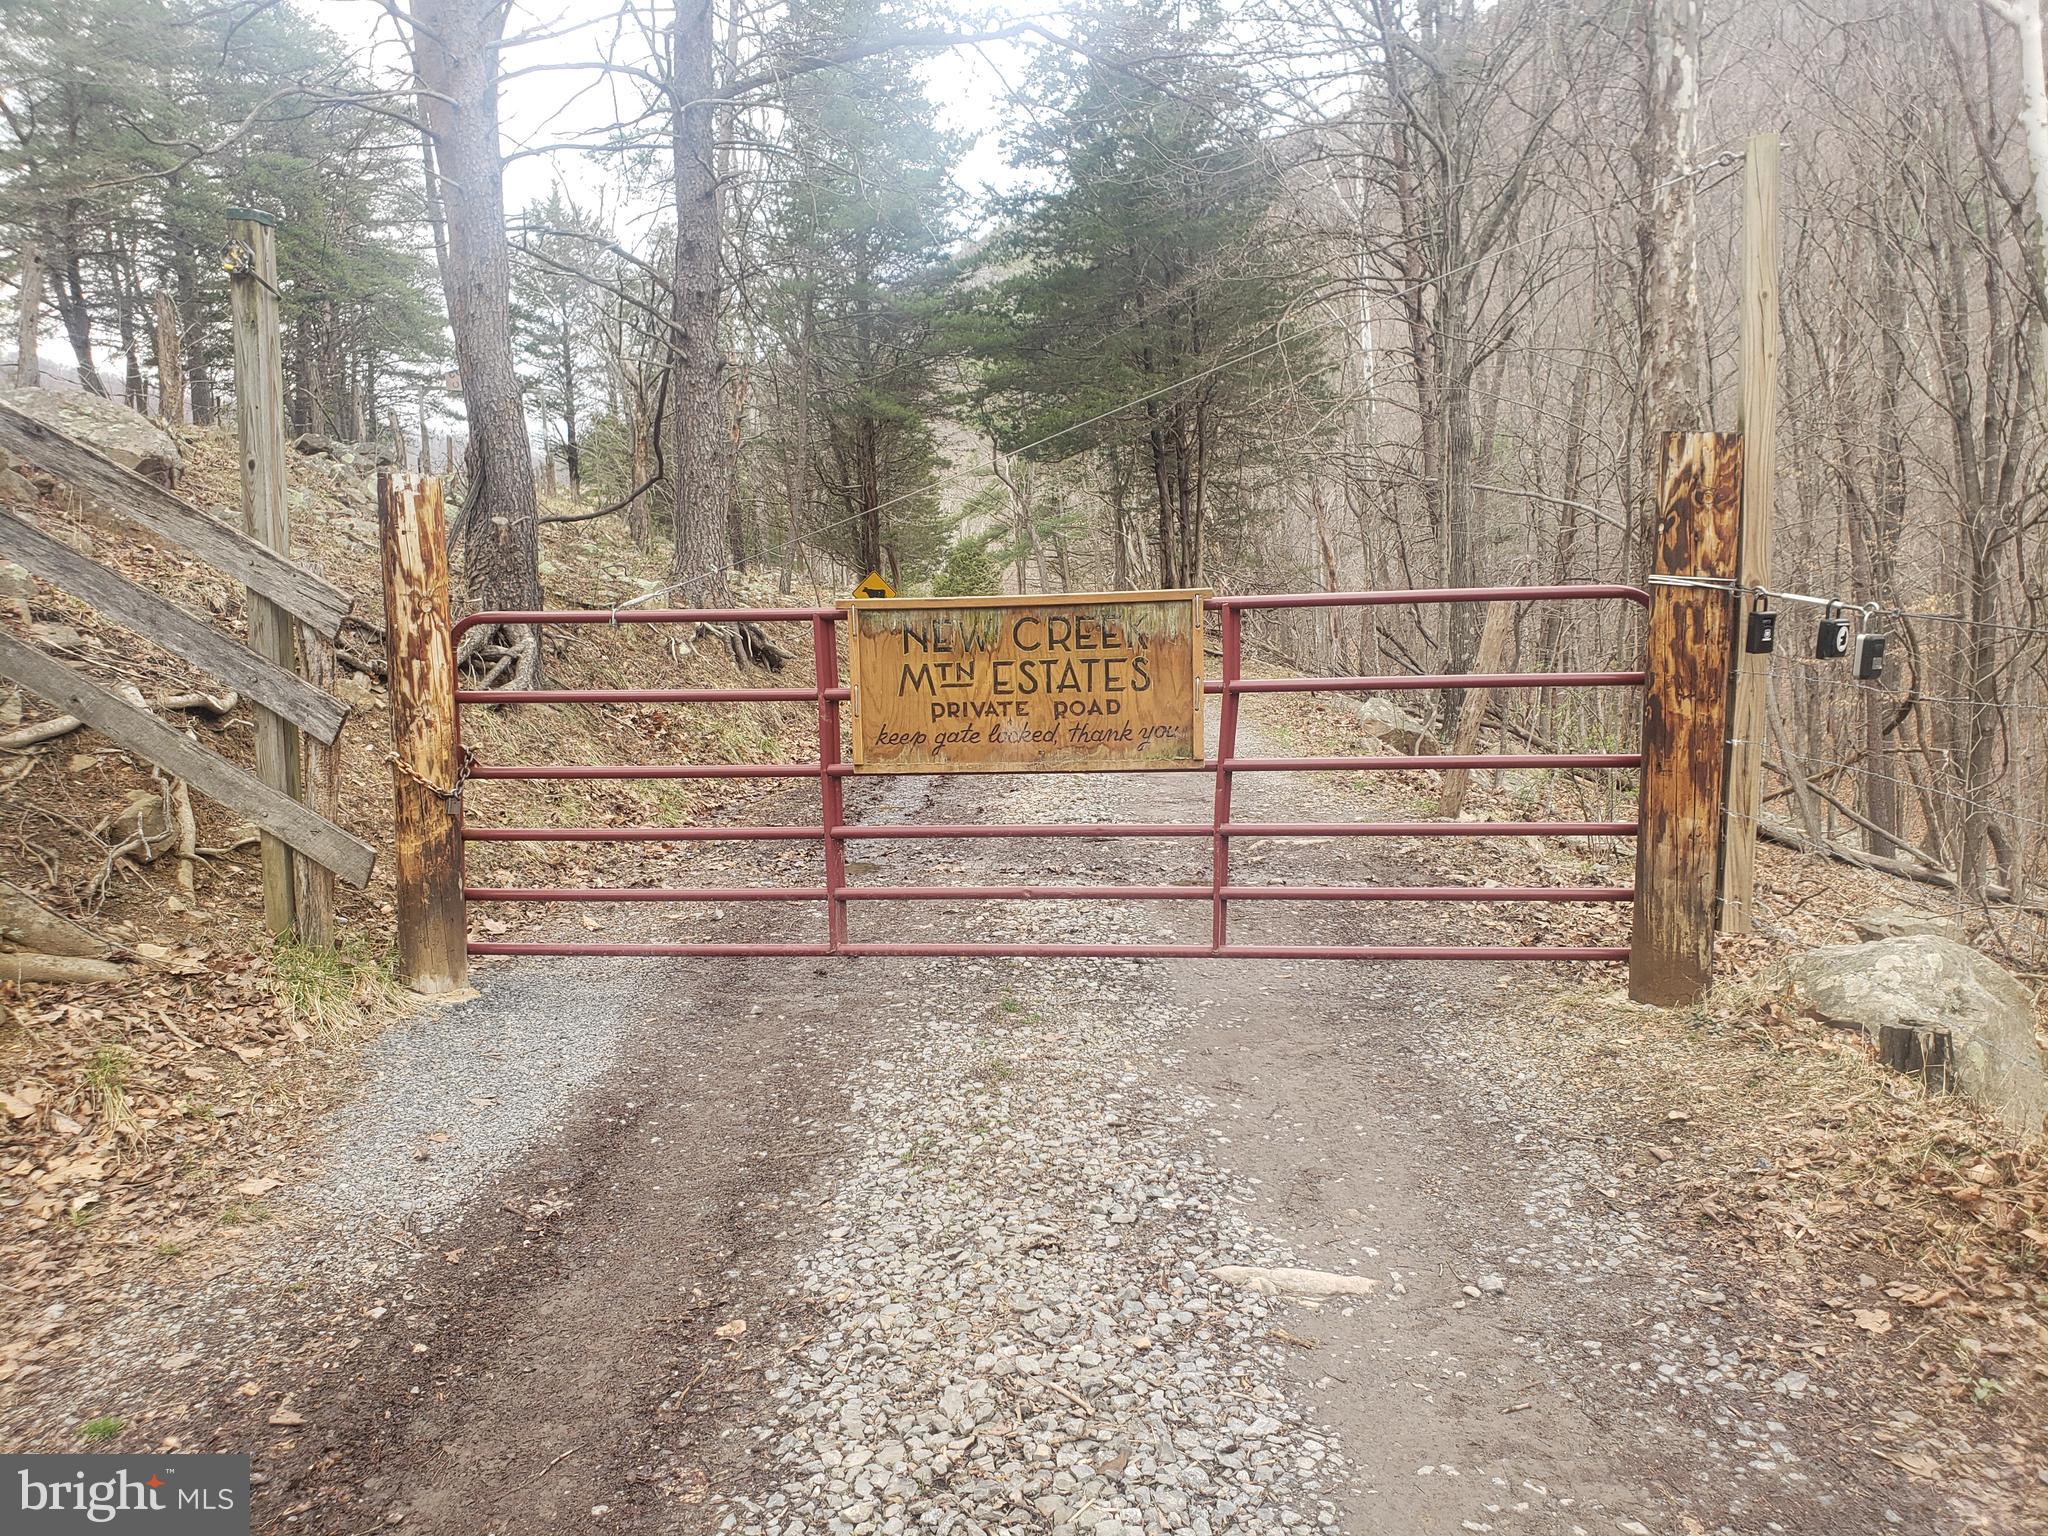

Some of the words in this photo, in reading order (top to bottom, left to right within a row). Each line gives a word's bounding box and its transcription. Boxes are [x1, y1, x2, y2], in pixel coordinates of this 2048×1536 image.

[903, 618, 999, 655] NEW
[1012, 614, 1148, 652] CREEK
[993, 656, 1152, 696] ESTATES
[930, 700, 1030, 723] PRIVATE
[1053, 698, 1121, 720] ROAD
[875, 723, 927, 751] keep
[931, 722, 982, 756] gate
[1068, 720, 1134, 743] thank
[1137, 725, 1179, 752] you
